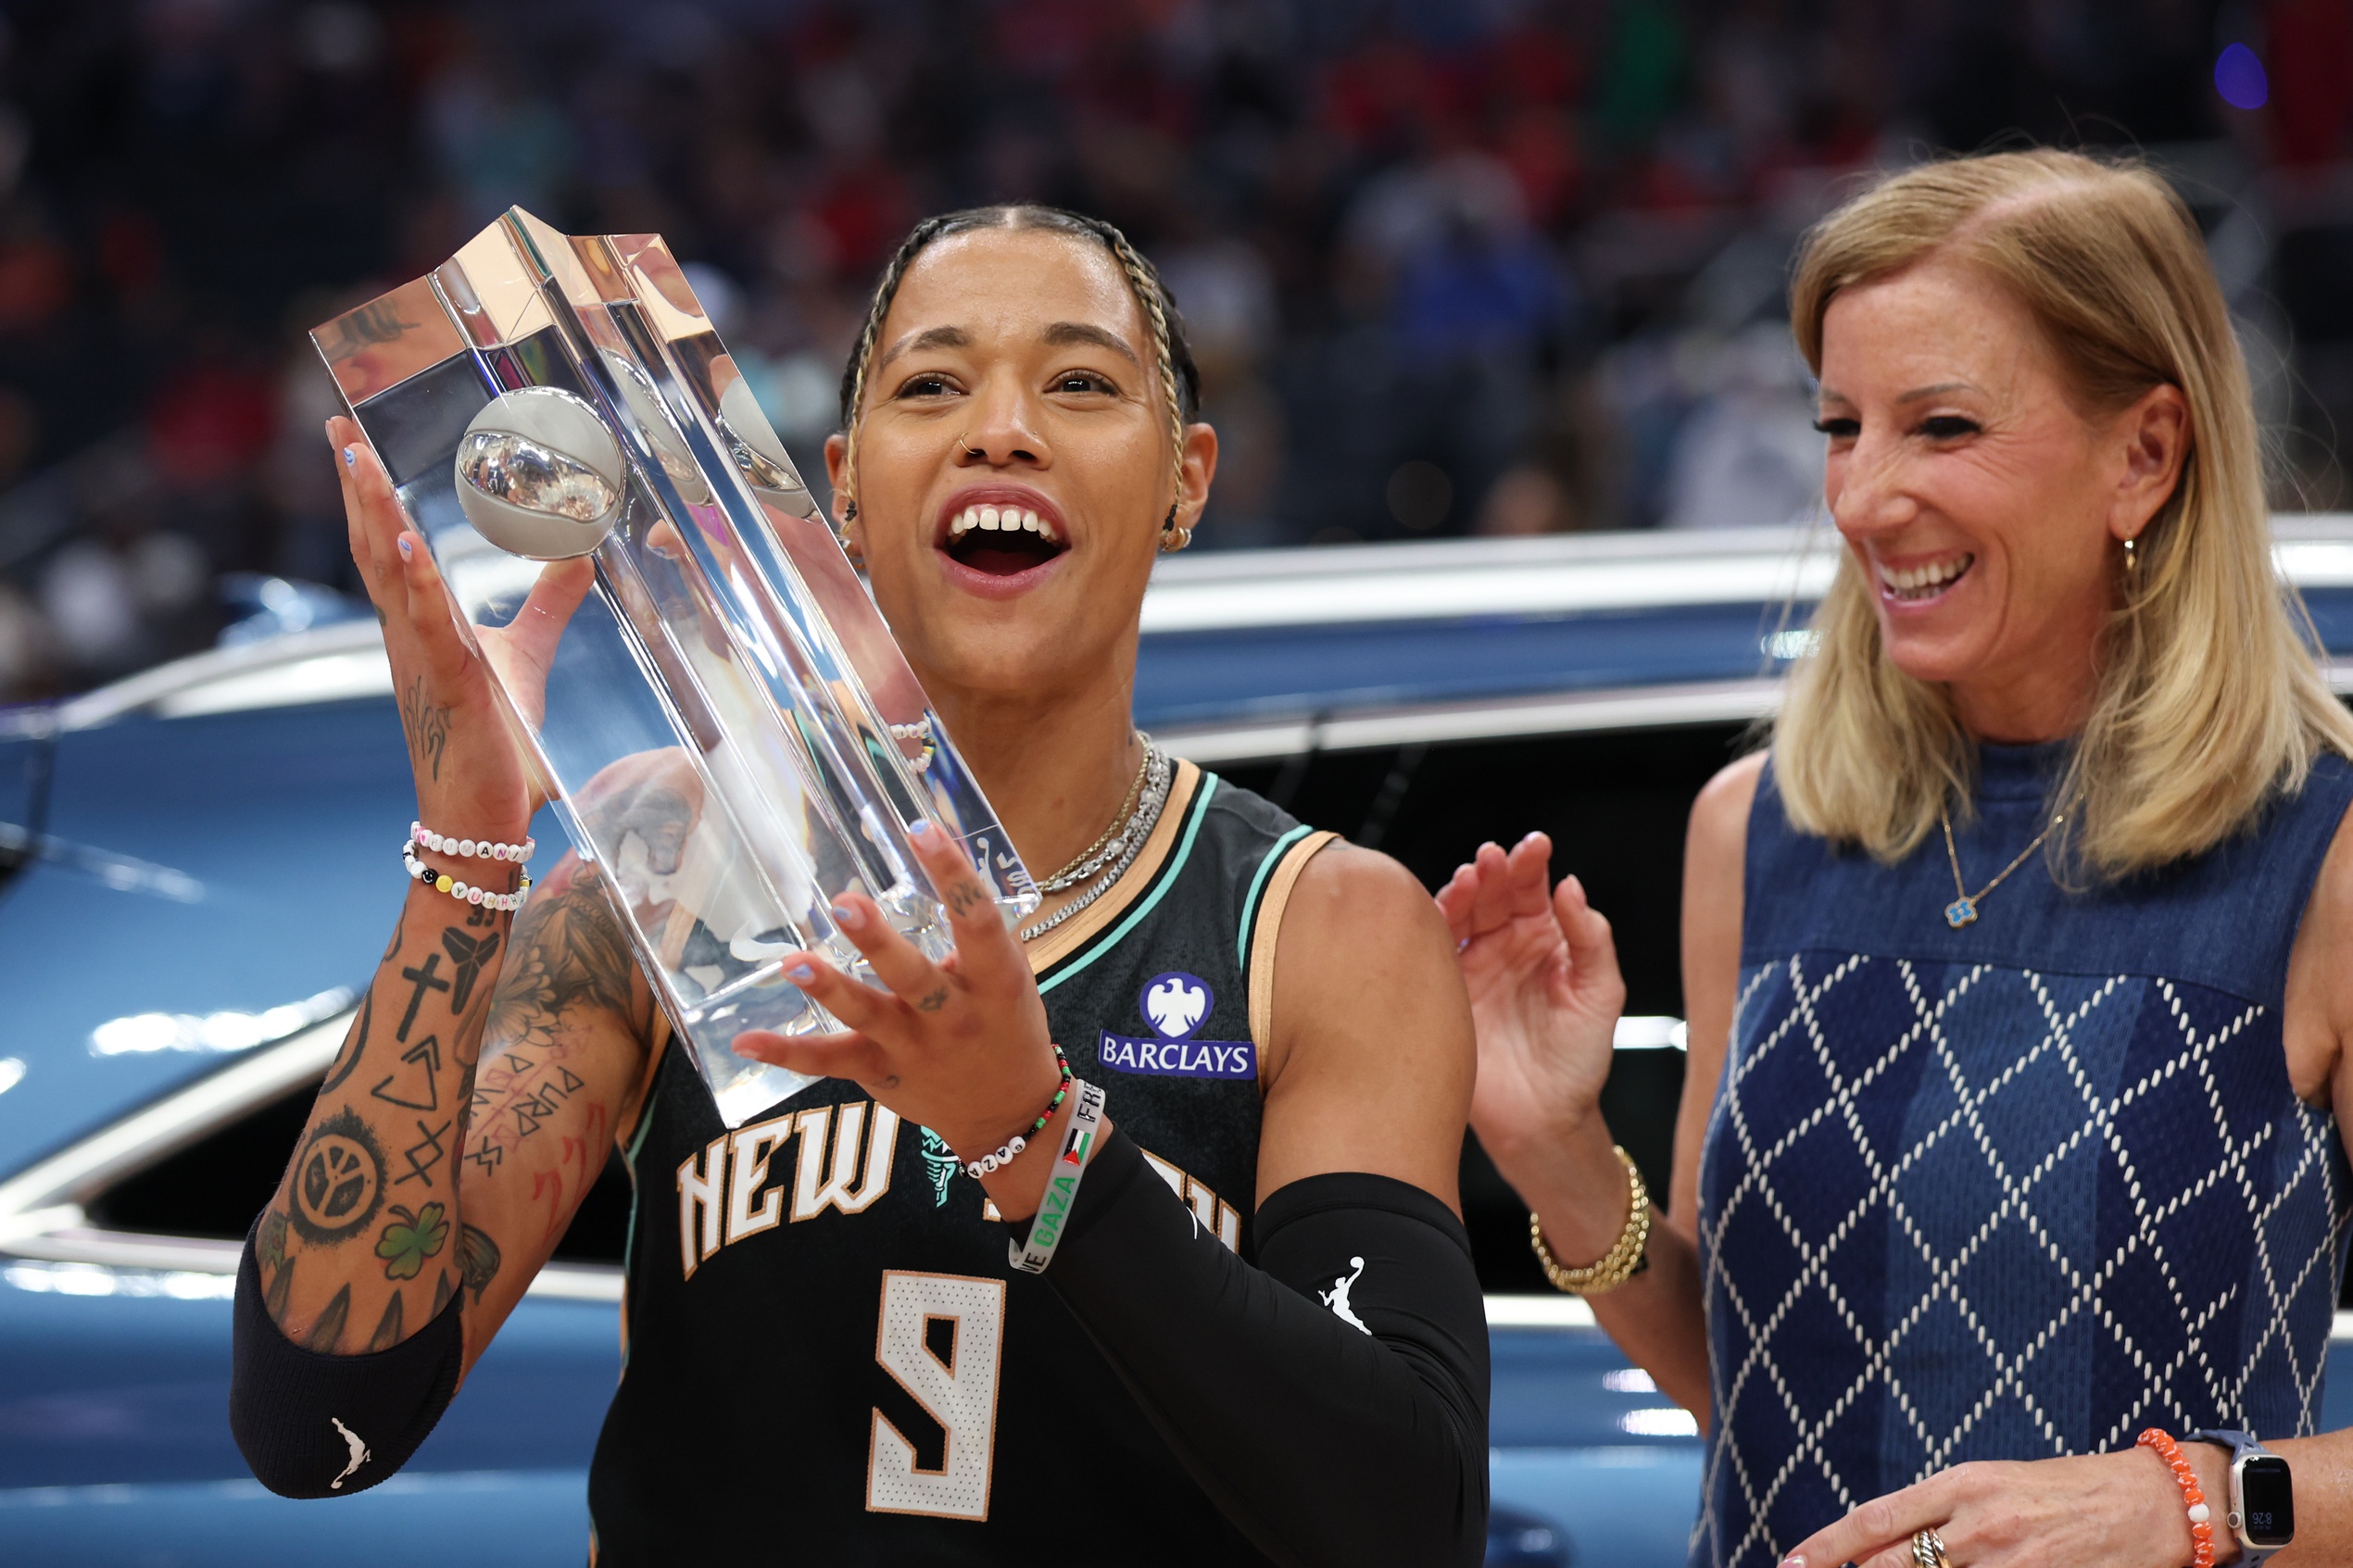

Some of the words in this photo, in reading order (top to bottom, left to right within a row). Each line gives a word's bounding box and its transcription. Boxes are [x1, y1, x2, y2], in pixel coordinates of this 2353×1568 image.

[431, 838, 528, 859] HUMANI
[1102, 1036, 1249, 1073] BARCLAYS
[969, 1144, 1023, 1177] GAZA
[676, 1100, 900, 1282] NEW
[1034, 1177, 1076, 1248] GAZA
[866, 1269, 1007, 1522] 9
[2252, 1512, 2272, 1525] 8:26
